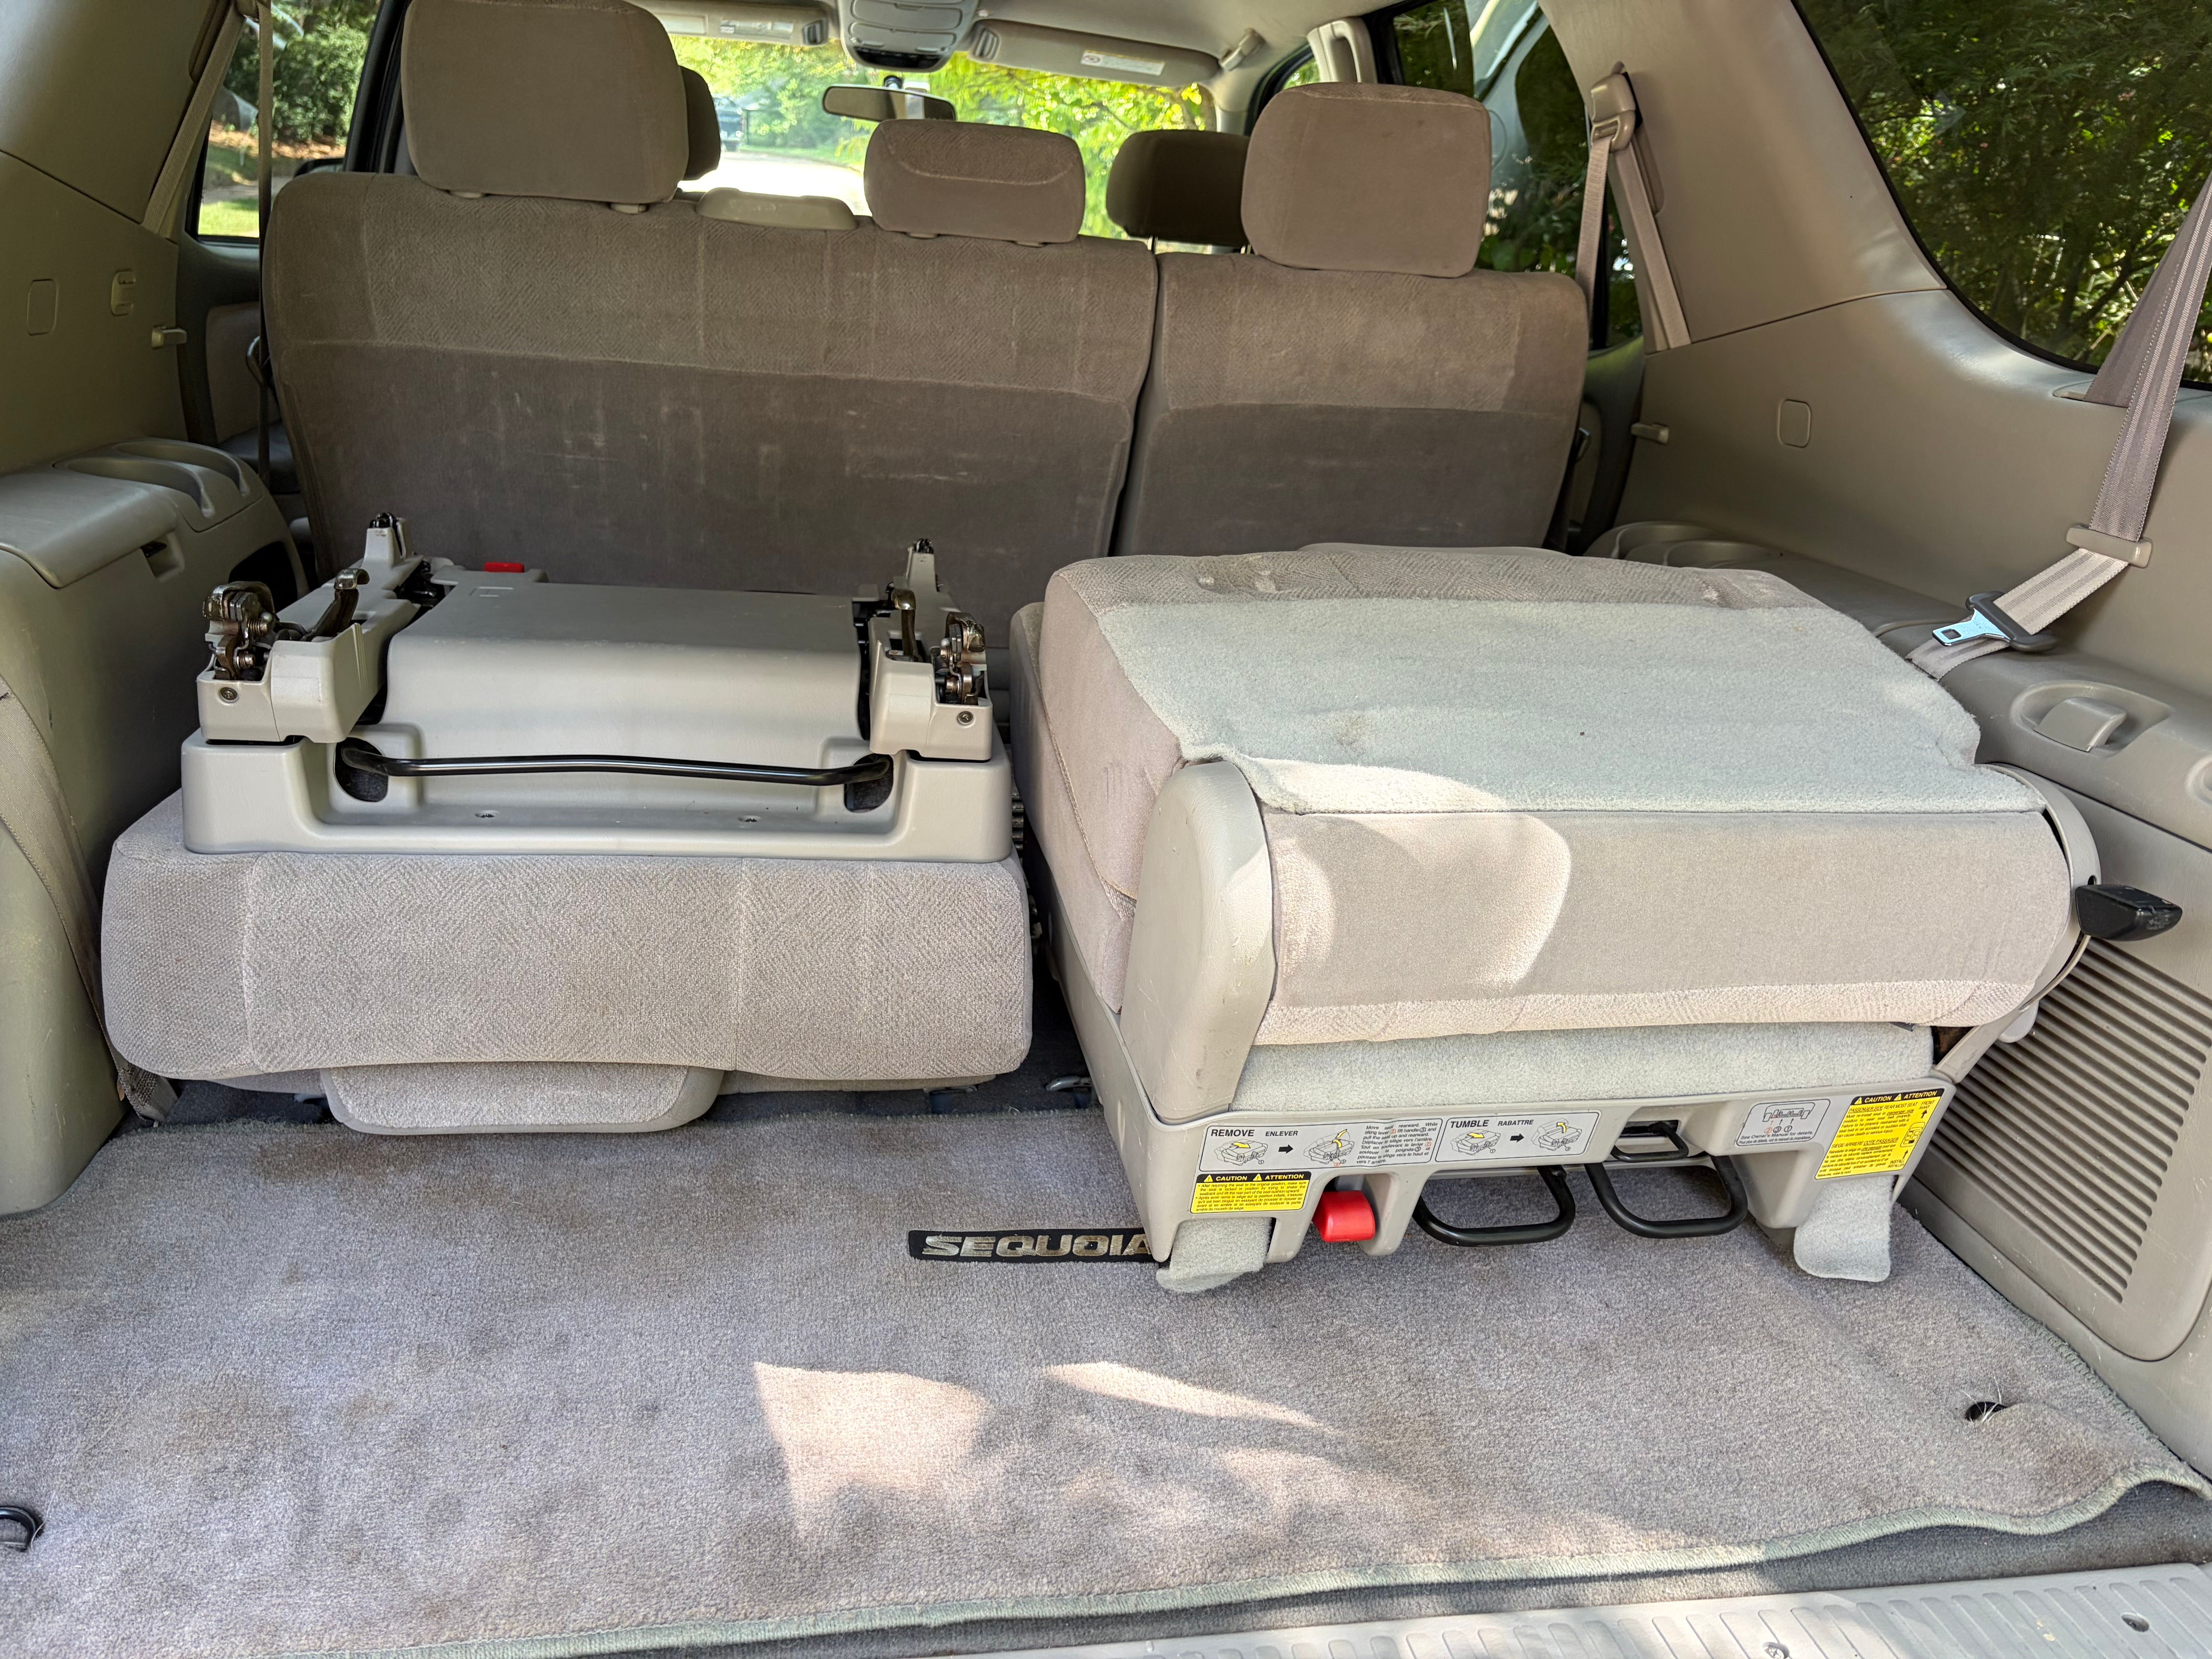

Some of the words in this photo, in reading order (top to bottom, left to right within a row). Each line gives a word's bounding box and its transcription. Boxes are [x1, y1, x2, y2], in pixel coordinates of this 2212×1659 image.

[1904, 1091, 1937, 1099] ATTENTION
[1450, 1120, 1489, 1128] TUMBLE
[922, 1234, 1152, 1257] SEQUOIA
